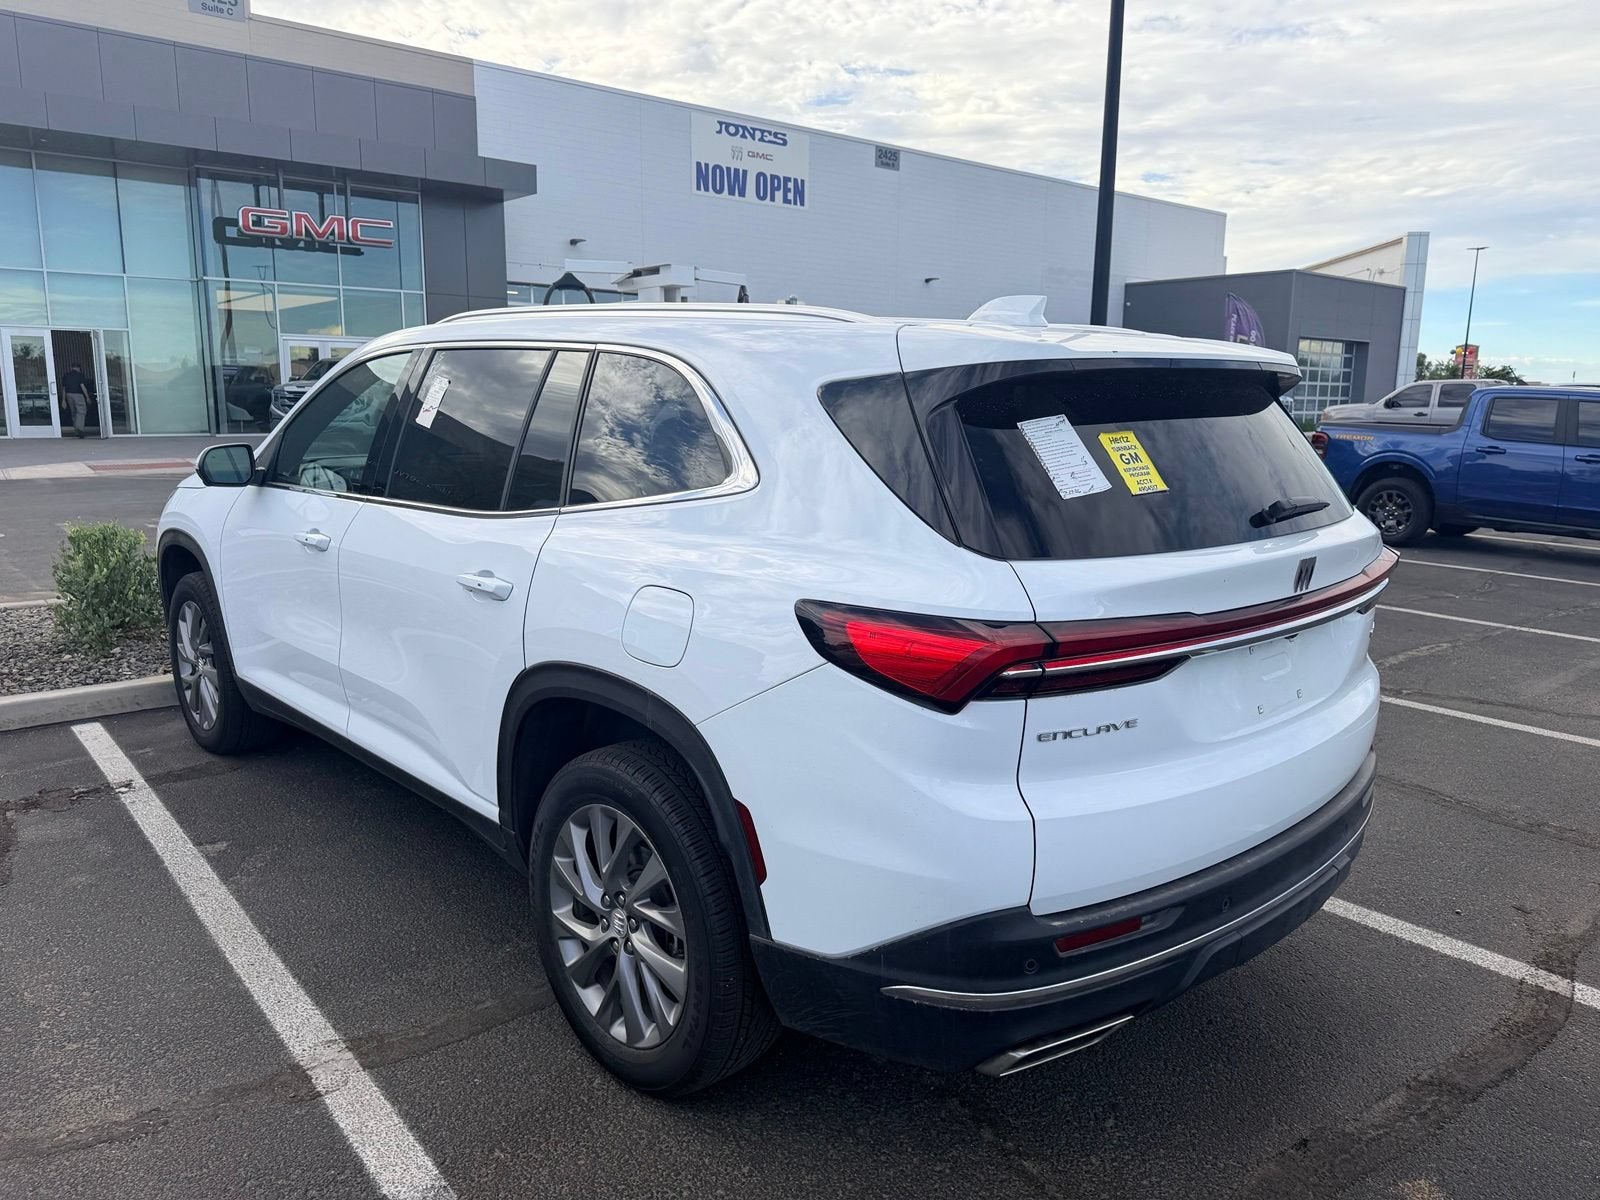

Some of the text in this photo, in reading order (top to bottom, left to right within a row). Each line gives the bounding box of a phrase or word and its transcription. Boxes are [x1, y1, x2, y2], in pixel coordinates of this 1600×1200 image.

[201, 2, 225, 14] Suite
[226, 8, 234, 16] C
[716, 120, 788, 147] JONES
[747, 150, 774, 162] GMC
[878, 149, 898, 162] 2425
[696, 161, 805, 207] NOW OPEN
[238, 206, 394, 248] GMC
[1108, 436, 1131, 444] Hertz
[1334, 433, 1375, 441] TREMOR
[1111, 444, 1139, 452] TURNBACK
[1119, 452, 1143, 465] GM
[1036, 718, 1139, 742] ENCLAVE
